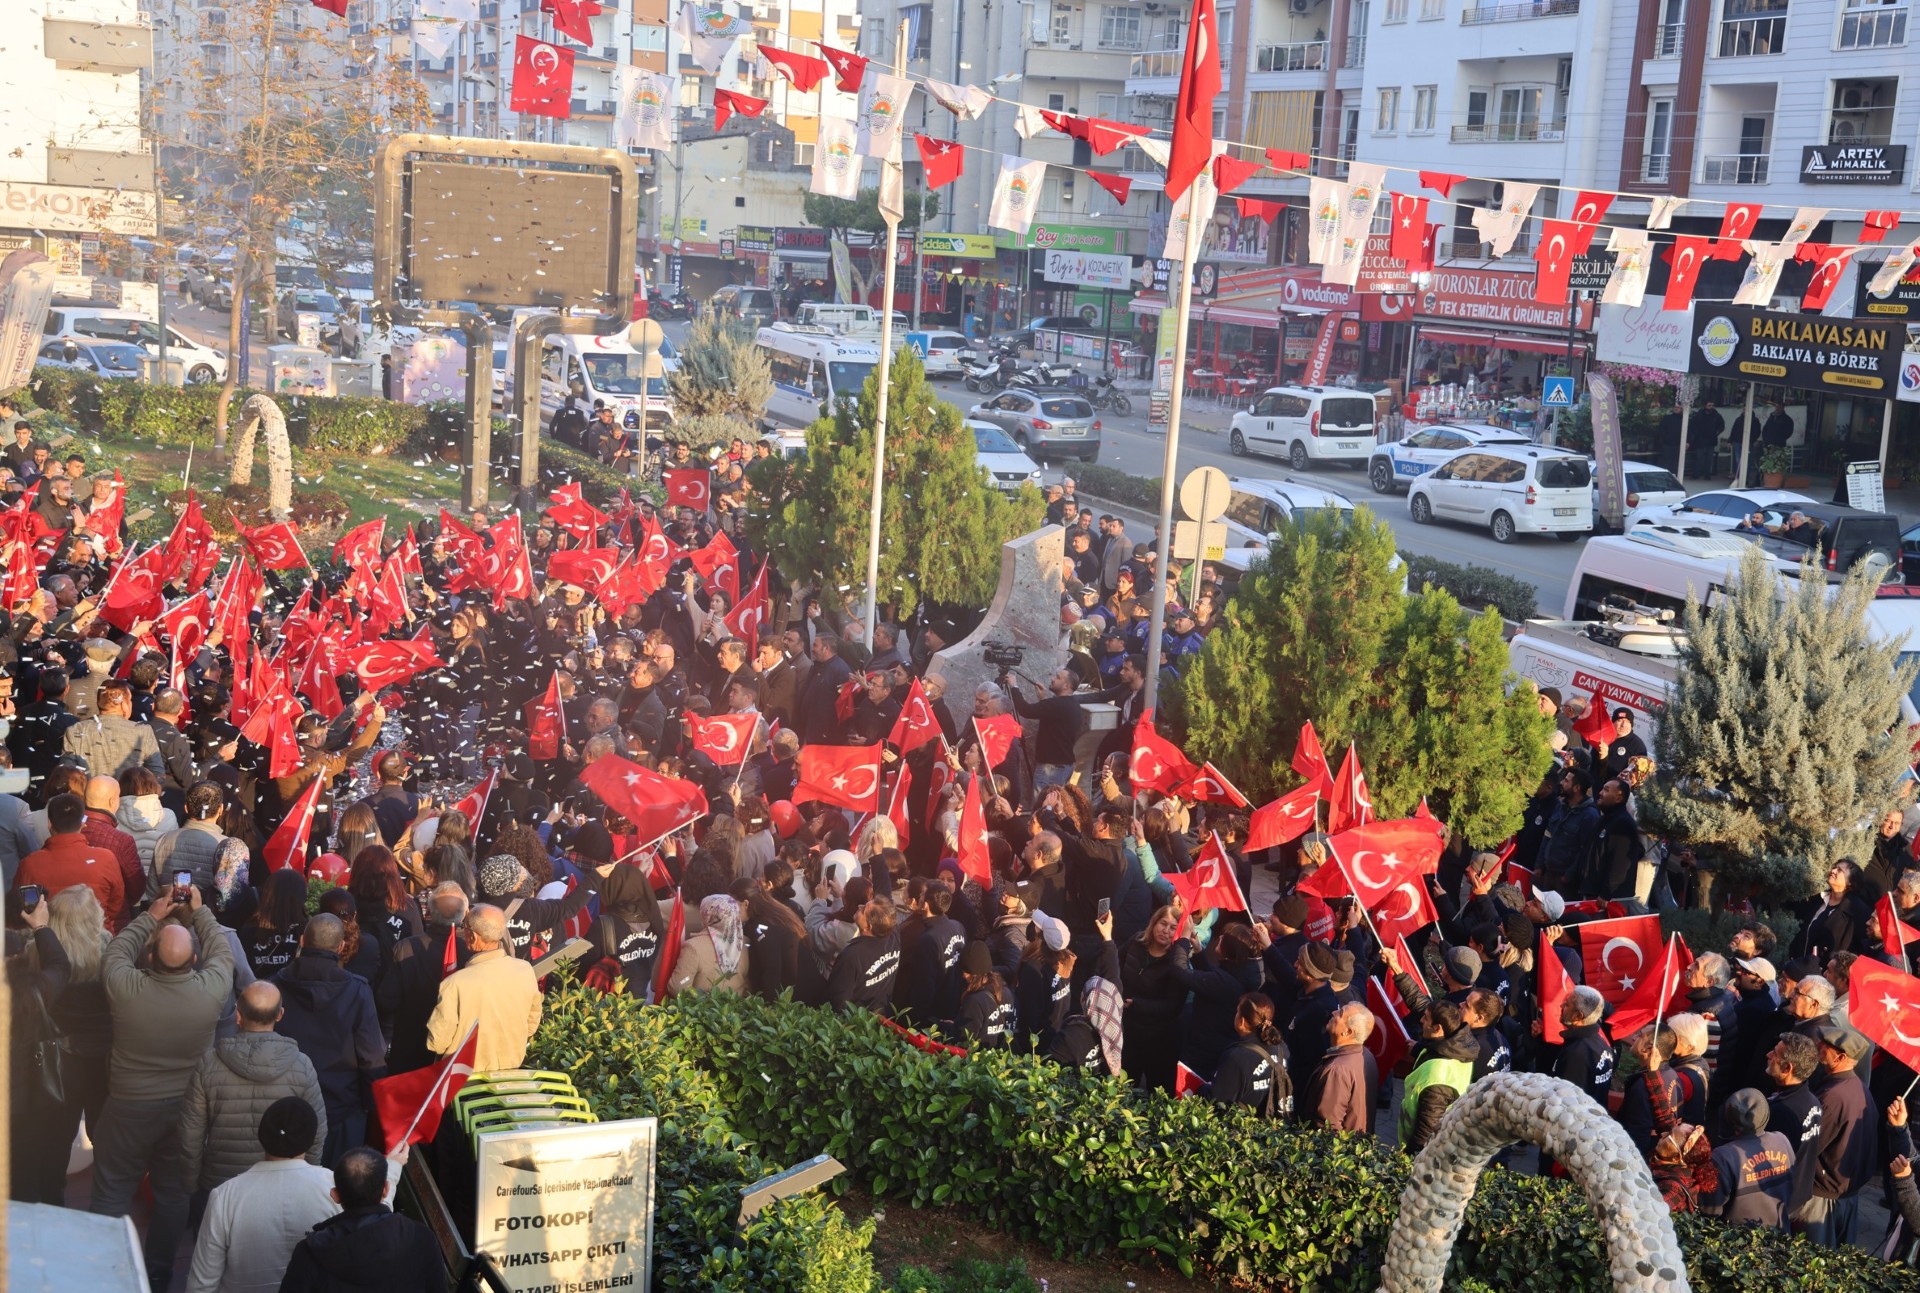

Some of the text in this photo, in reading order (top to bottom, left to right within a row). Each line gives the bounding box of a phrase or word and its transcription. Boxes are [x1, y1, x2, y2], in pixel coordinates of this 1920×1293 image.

[1837, 148, 1883, 159] ARTEV
[1831, 160, 1886, 169] MİMARLIK
[1035, 227, 1058, 246] Bey
[1087, 258, 1124, 276] KOZMETİK
[1361, 271, 1376, 279] TEX
[1571, 262, 1615, 276] EKÇİLİK
[1301, 285, 1349, 305] vodafone
[1432, 272, 1536, 300] TOROSLAR ZÜCC
[1439, 300, 1457, 315] TEX
[1513, 303, 1565, 326] ÜRÜNLERİ
[1622, 301, 1682, 343] Sakura
[1750, 317, 1887, 350] BAKLAVASAN
[1309, 319, 1336, 386] vodafone
[1752, 344, 1879, 371] BAKLAVA & BÖREK
[1401, 463, 1420, 474] POLİS
[1537, 657, 1558, 670] KANAL
[1578, 674, 1606, 694] CANI
[1606, 685, 1635, 704] YAYIN
[619, 930, 658, 951] TOROSLAR
[254, 952, 292, 965] BELEDİ
[619, 944, 656, 962] BELEDİYESİ
[1742, 1150, 1788, 1173] TOROSLAR
[1745, 1165, 1787, 1183] BELEDİYESİ
[496, 1182, 543, 1197] CarrefourSa
[543, 1179, 582, 1197] İçerisinde
[494, 1206, 594, 1232] FOTOKOPİ
[494, 1240, 626, 1269] WHATSAPP ÇIKTI
[565, 1271, 634, 1293] İŞLEMLERİ
